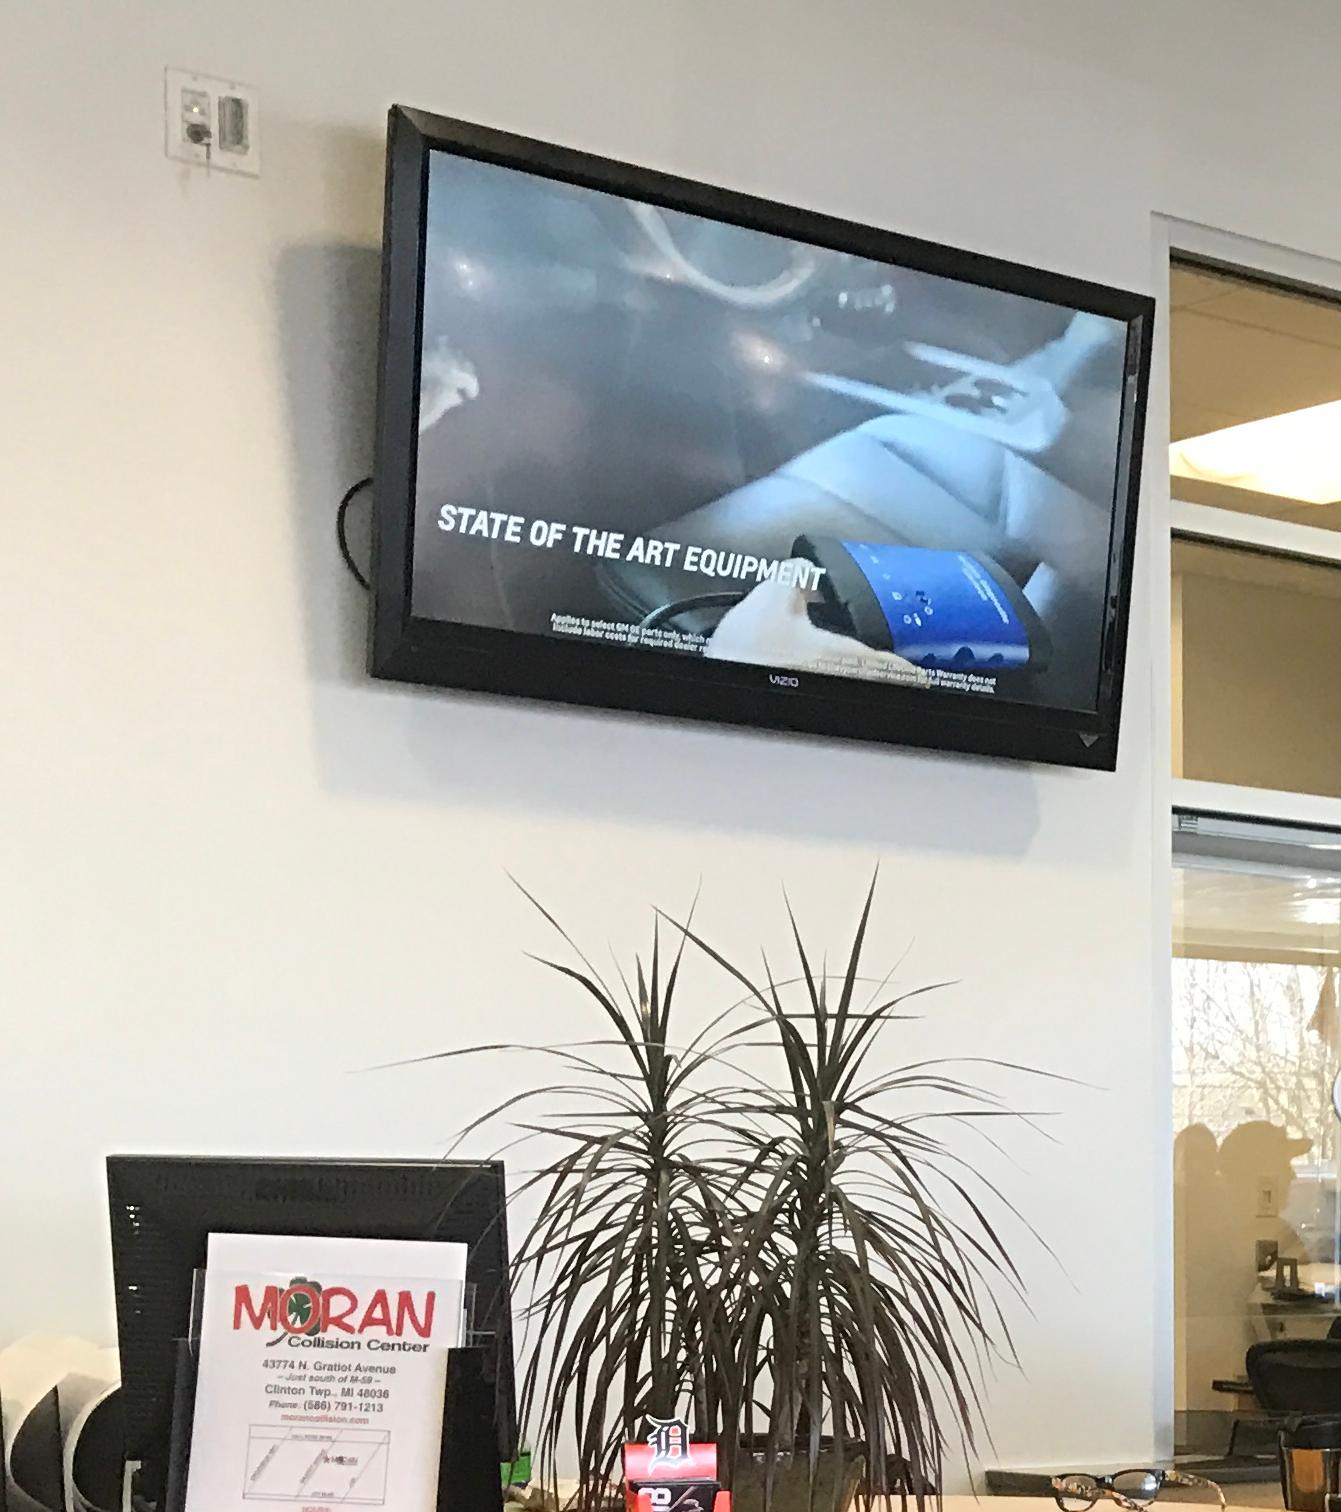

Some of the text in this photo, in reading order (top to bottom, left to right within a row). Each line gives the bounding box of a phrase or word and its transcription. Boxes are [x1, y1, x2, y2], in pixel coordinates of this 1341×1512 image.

[437, 503, 826, 591] STATE OF THE ART EQUIPMENT
[769, 674, 799, 687] VIZIO
[233, 1283, 436, 1338] MORAN
[288, 1335, 430, 1353] Collision Center
[262, 1359, 396, 1375] 43774 N. Gratiot Avenue
[285, 1372, 306, 1382] Just
[308, 1373, 335, 1383] south
[338, 1375, 348, 1383] of
[265, 1384, 305, 1396] Clinton
[341, 1387, 354, 1398] MI
[357, 1388, 389, 1399] 48036
[334, 1401, 384, 1413] 791-1213
